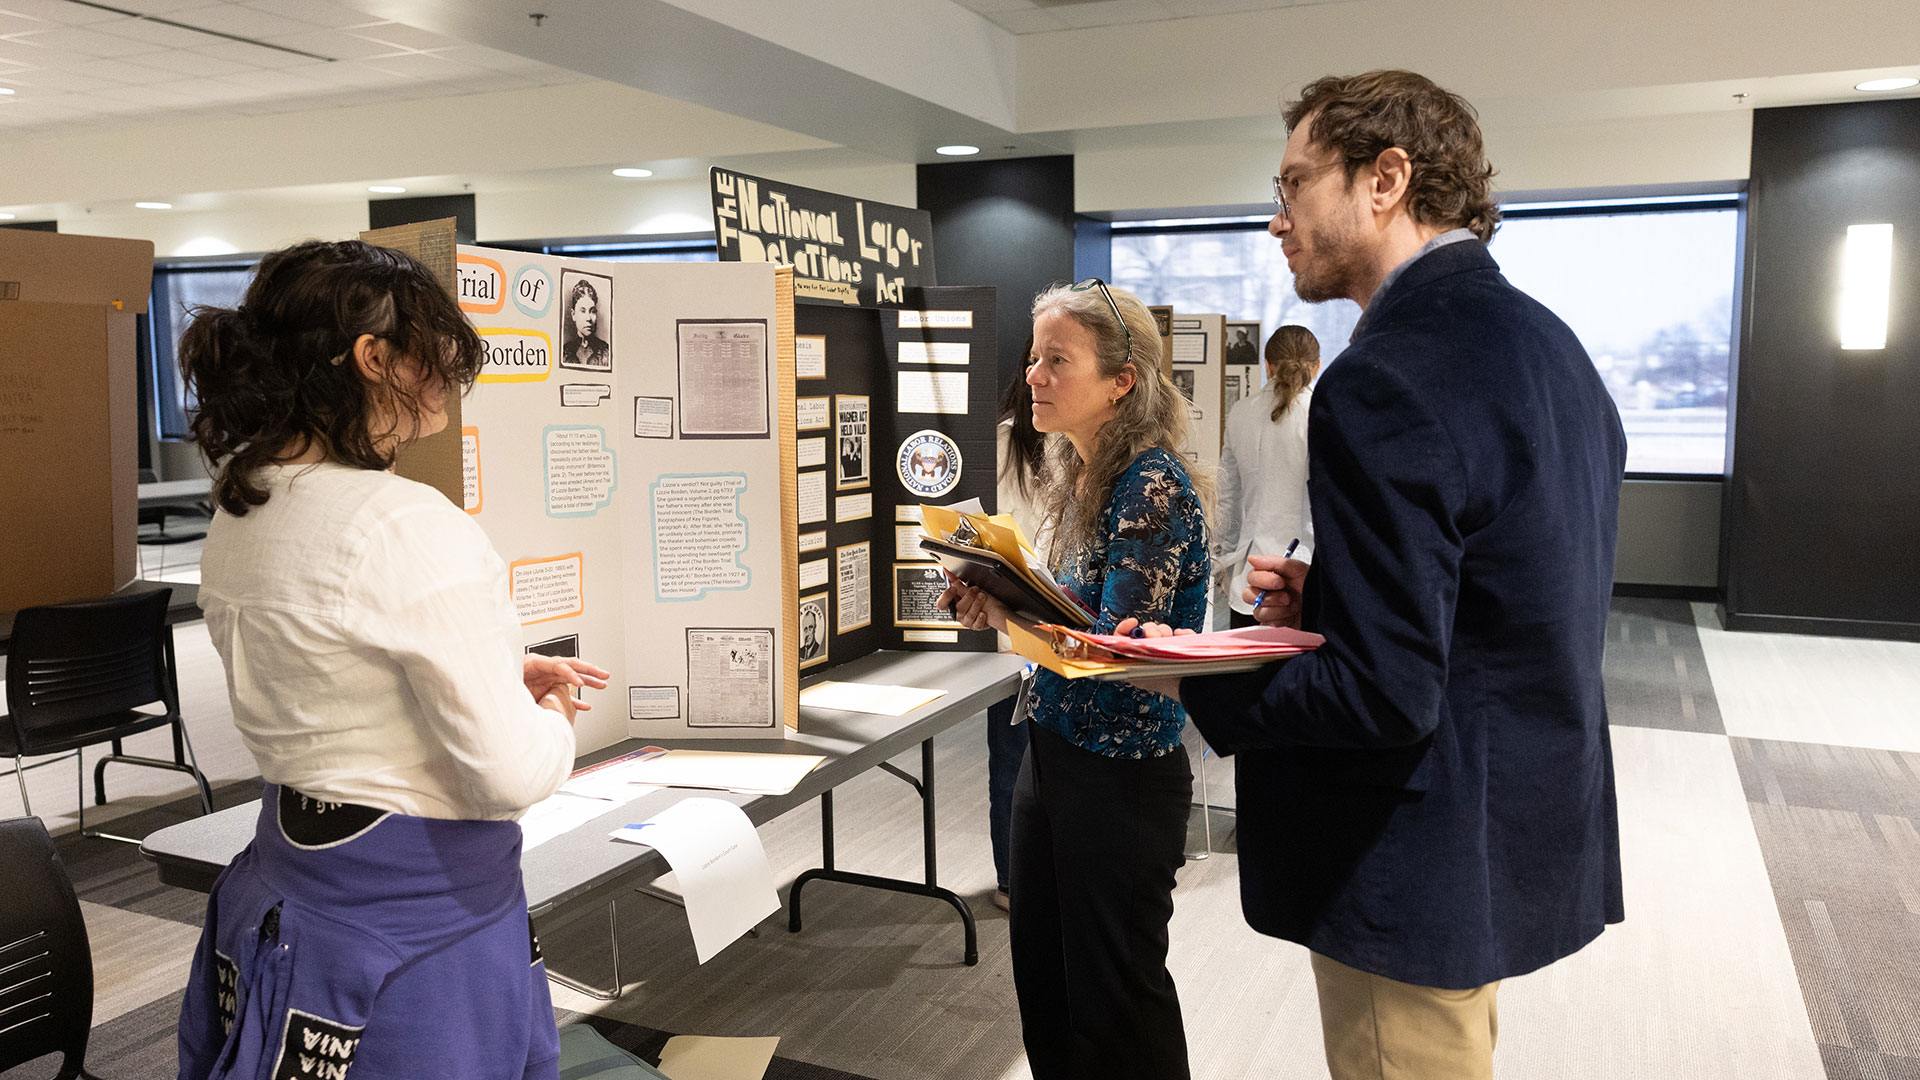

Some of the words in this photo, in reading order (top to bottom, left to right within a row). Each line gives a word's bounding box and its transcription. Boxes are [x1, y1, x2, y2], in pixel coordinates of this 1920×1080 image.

[520, 279, 544, 303] of
[481, 340, 547, 366] Borden
[840, 411, 858, 423] WAGNER
[860, 411, 868, 422] ACT
[841, 424, 853, 436] HELD
[854, 424, 867, 435] VALID
[904, 437, 927, 458] LABOR
[928, 436, 958, 471] RELATIONS
[900, 455, 924, 492] NATIONAL
[930, 472, 956, 492] BOARD
